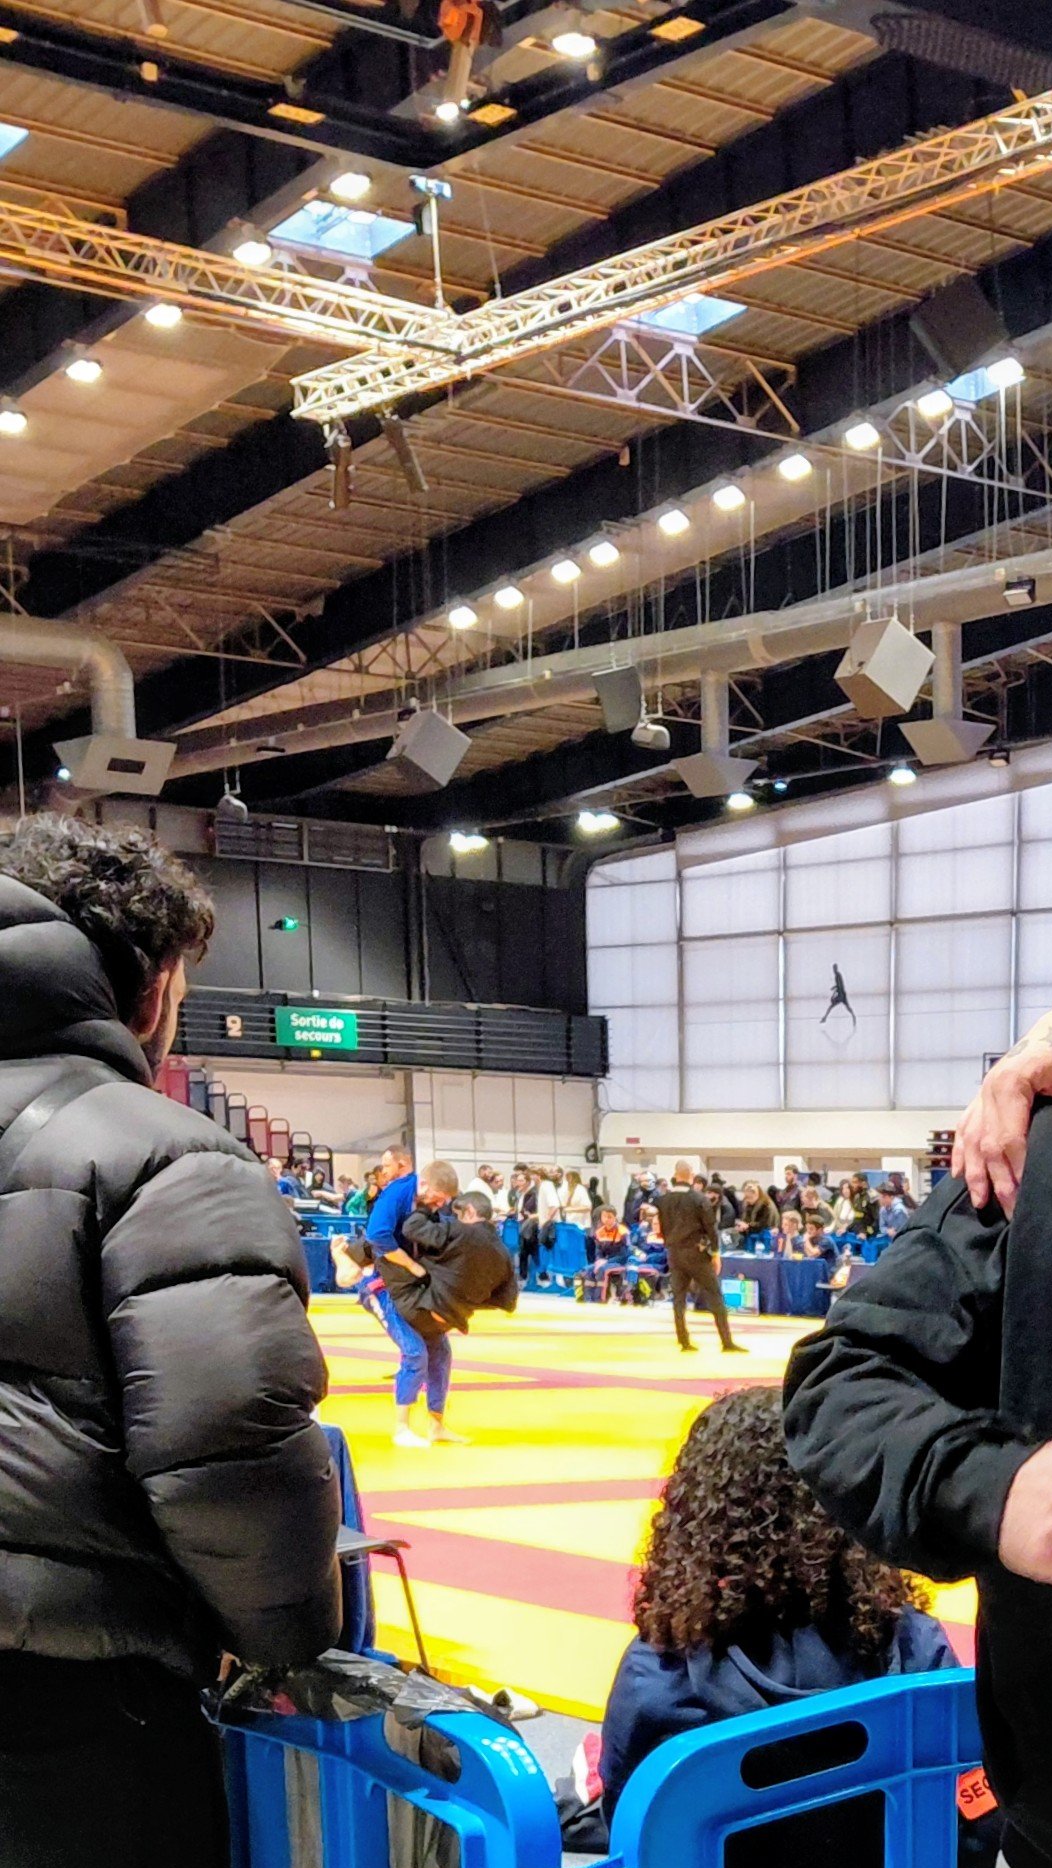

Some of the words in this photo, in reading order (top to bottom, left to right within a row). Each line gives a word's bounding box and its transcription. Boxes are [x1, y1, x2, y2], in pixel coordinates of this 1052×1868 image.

[226, 1015, 243, 1037] 2
[290, 1013, 327, 1028] Sortie
[329, 1016, 344, 1029] de
[294, 1030, 341, 1043] secours
